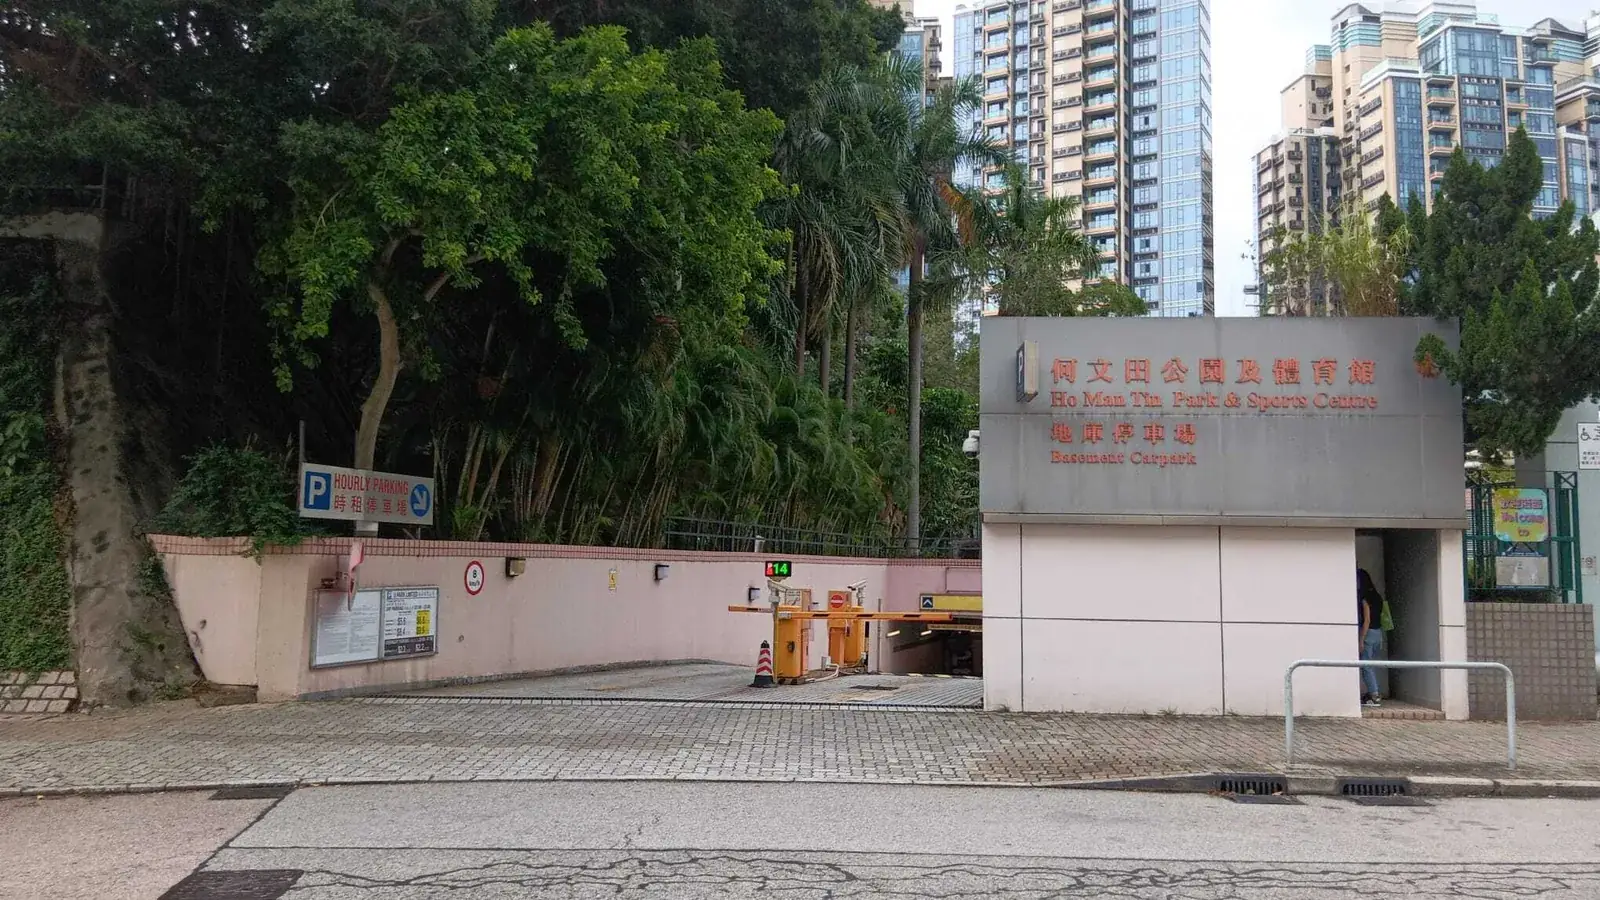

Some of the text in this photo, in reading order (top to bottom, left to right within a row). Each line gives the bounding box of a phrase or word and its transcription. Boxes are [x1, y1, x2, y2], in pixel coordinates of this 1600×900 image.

[1051, 357, 1376, 384] 何文田公園及體育館
[1050, 391, 1378, 412] Ho Man Tin Park & Sports Centre
[1051, 422, 1197, 445] 地庫停車場
[1051, 450, 1197, 467] Basement Carpark
[308, 475, 327, 506] P
[334, 473, 409, 496] HOURLY PARKING
[334, 495, 408, 516] 時租停車場
[472, 569, 478, 579] 8
[773, 563, 788, 575] 14
